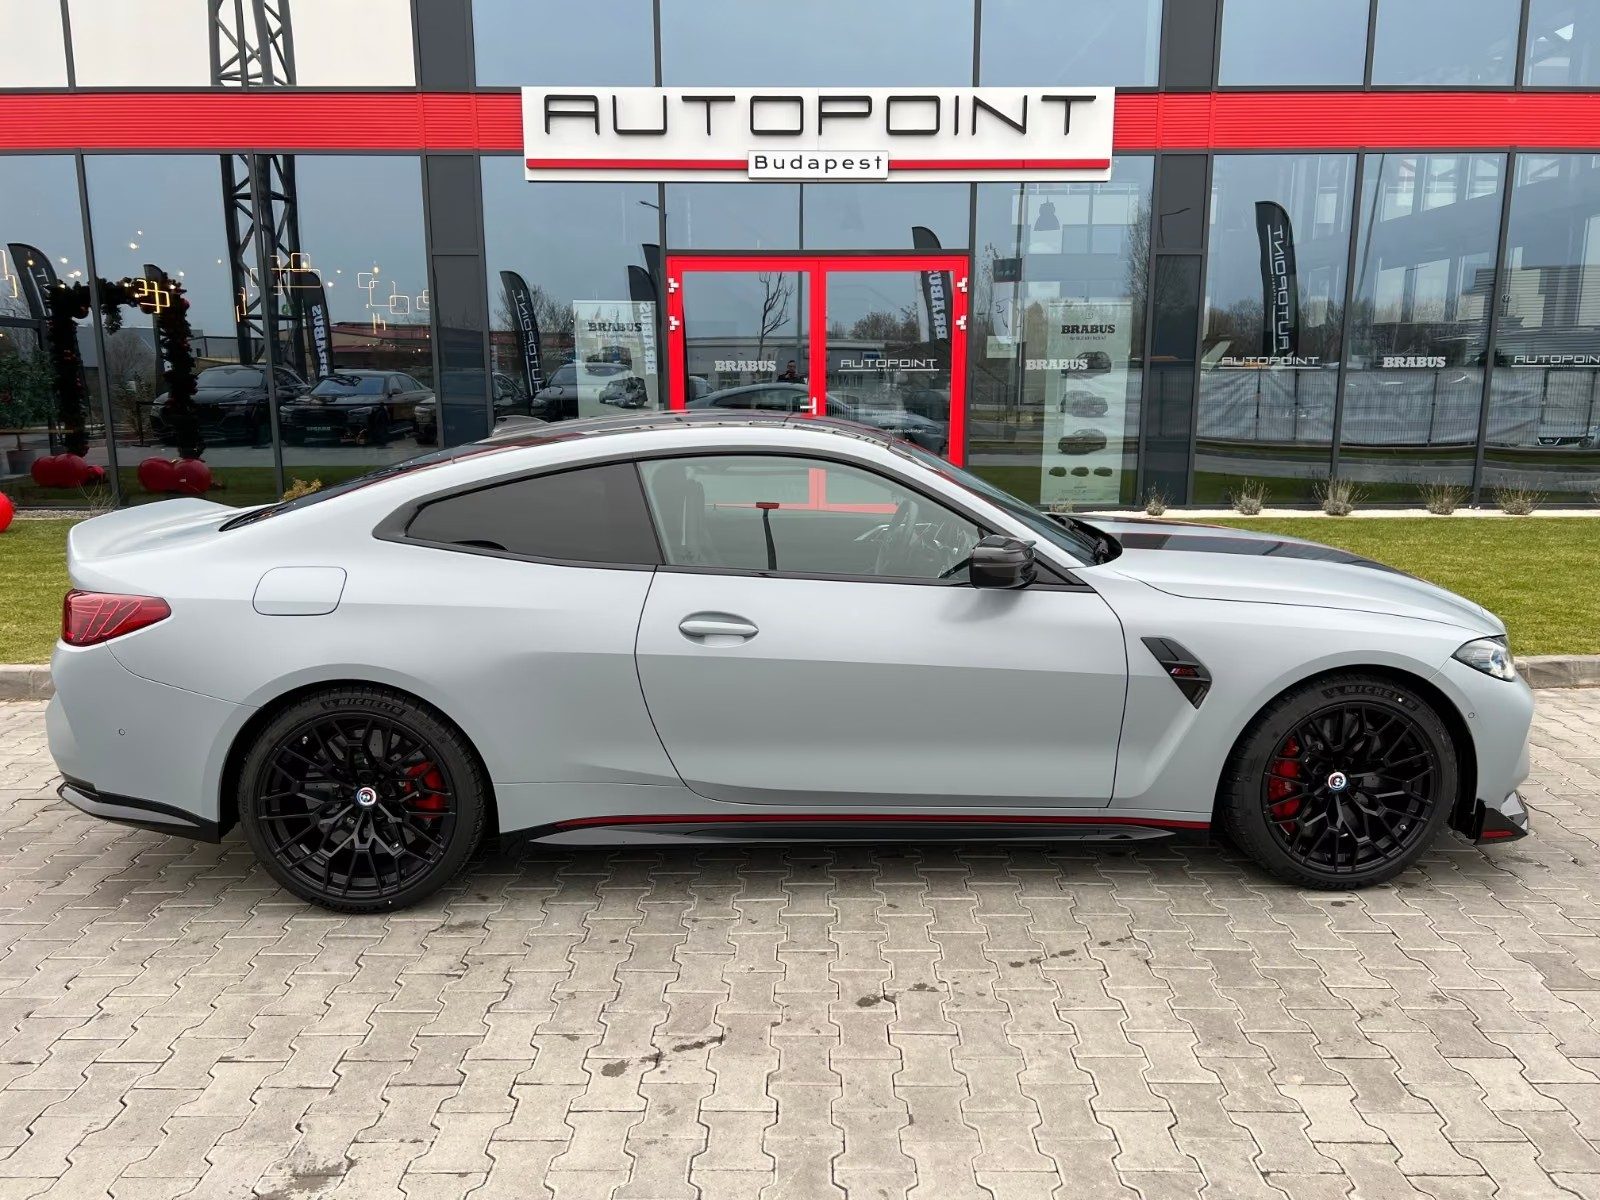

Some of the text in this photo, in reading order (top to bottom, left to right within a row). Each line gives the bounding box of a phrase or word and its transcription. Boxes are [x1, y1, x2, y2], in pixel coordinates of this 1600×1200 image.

[544, 94, 1097, 136] AUTOPOINT
[754, 154, 882, 174] Budapest
[587, 322, 643, 332] BRABUS
[1060, 324, 1116, 334] BRABUS
[840, 359, 938, 368] AUTOPOINT
[1025, 358, 1089, 370] BRABUS
[1221, 356, 1320, 365] AUTOPOINT
[1382, 356, 1446, 368] BRABUS
[1514, 355, 1600, 364] AUTOPOIN
[714, 360, 777, 372] BRABUS
[1345, 685, 1415, 708] MICHELN
